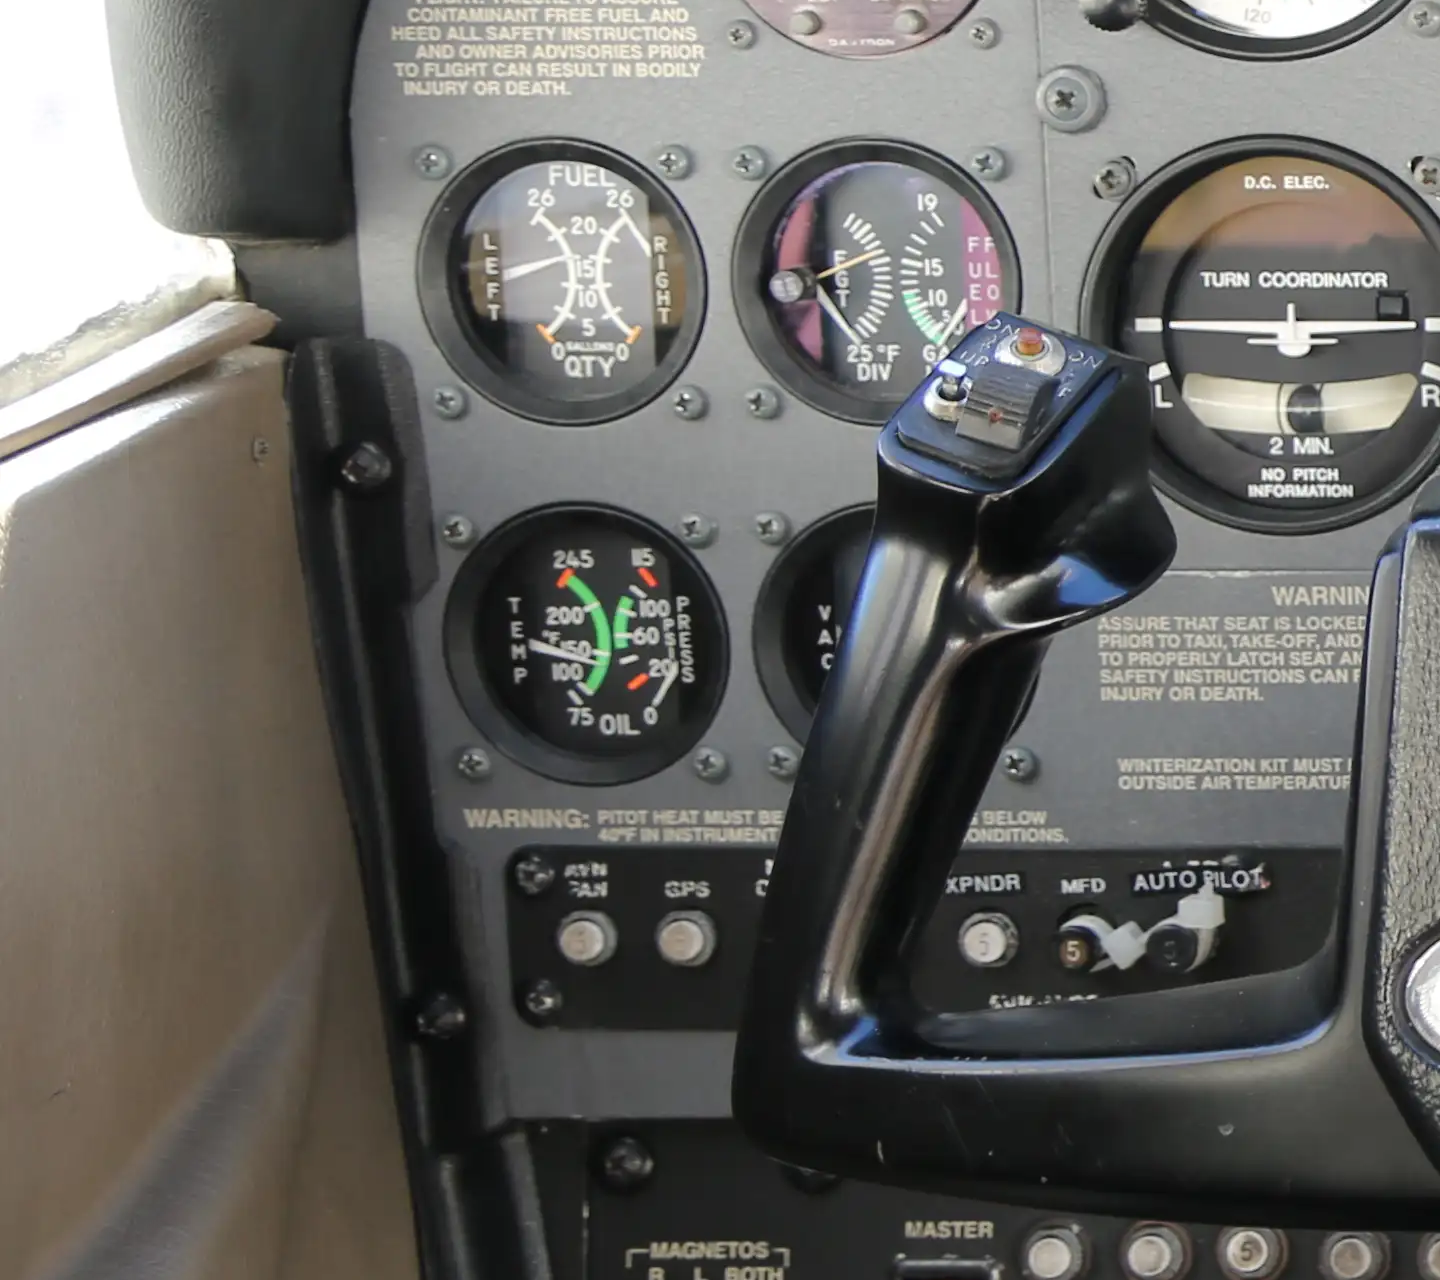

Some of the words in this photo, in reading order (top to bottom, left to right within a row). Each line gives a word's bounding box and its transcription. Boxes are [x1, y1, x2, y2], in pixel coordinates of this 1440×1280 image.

[548, 164, 617, 188] FUEL
[1244, 175, 1277, 190] D.C.
[1283, 175, 1330, 190] ELEC.
[1200, 271, 1250, 288] TURN
[1258, 271, 1388, 289] COORDINATOR
[564, 355, 616, 378] QTY
[1269, 436, 1284, 455] 2
[1292, 436, 1334, 455] MIN.
[1260, 467, 1286, 482] NO
[1292, 467, 1340, 482] PITCH
[1247, 483, 1354, 499] INFORMATION
[599, 713, 641, 736] OIL
[904, 1220, 994, 1239] MASTER
[649, 1240, 770, 1260] MAGNETOS
